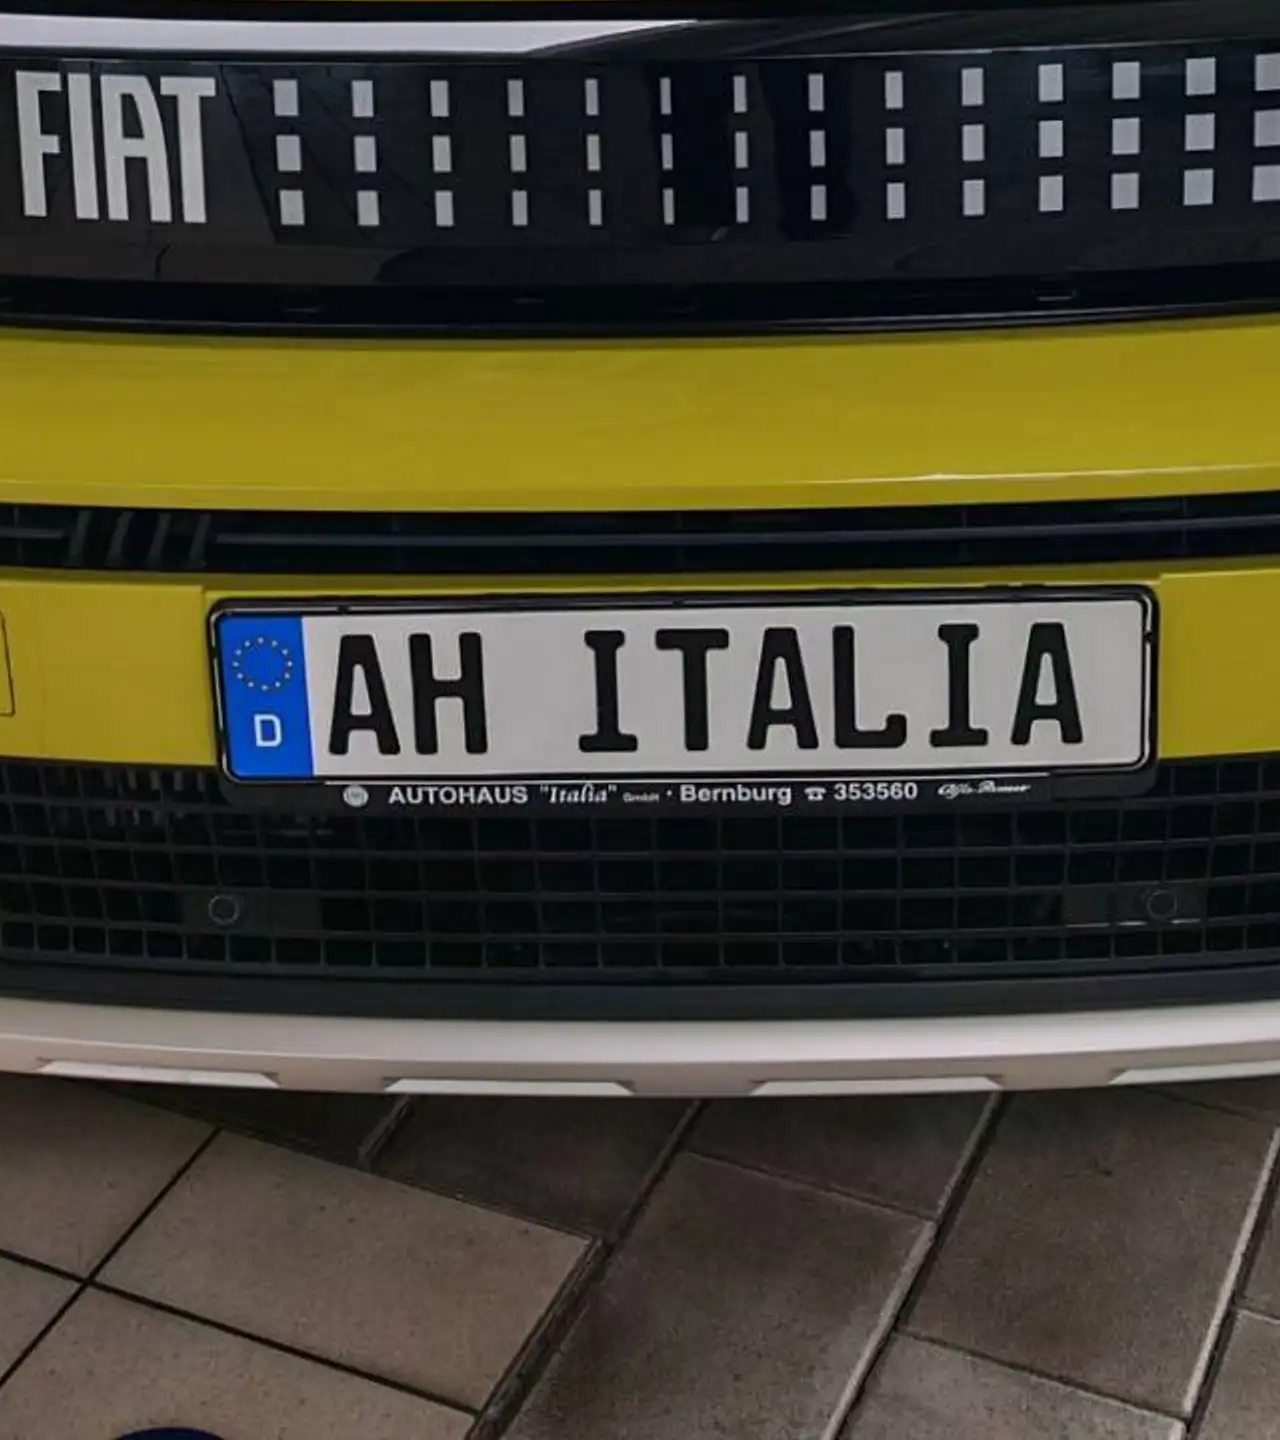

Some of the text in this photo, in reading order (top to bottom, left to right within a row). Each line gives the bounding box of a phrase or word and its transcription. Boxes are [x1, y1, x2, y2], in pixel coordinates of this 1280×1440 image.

[16, 70, 216, 224] FIAT
[254, 714, 283, 748] D
[328, 622, 1083, 756] AH ITALIA
[388, 786, 528, 804] AUTOHAUS
[680, 784, 792, 805] Bernburg
[834, 782, 918, 800] 353560
